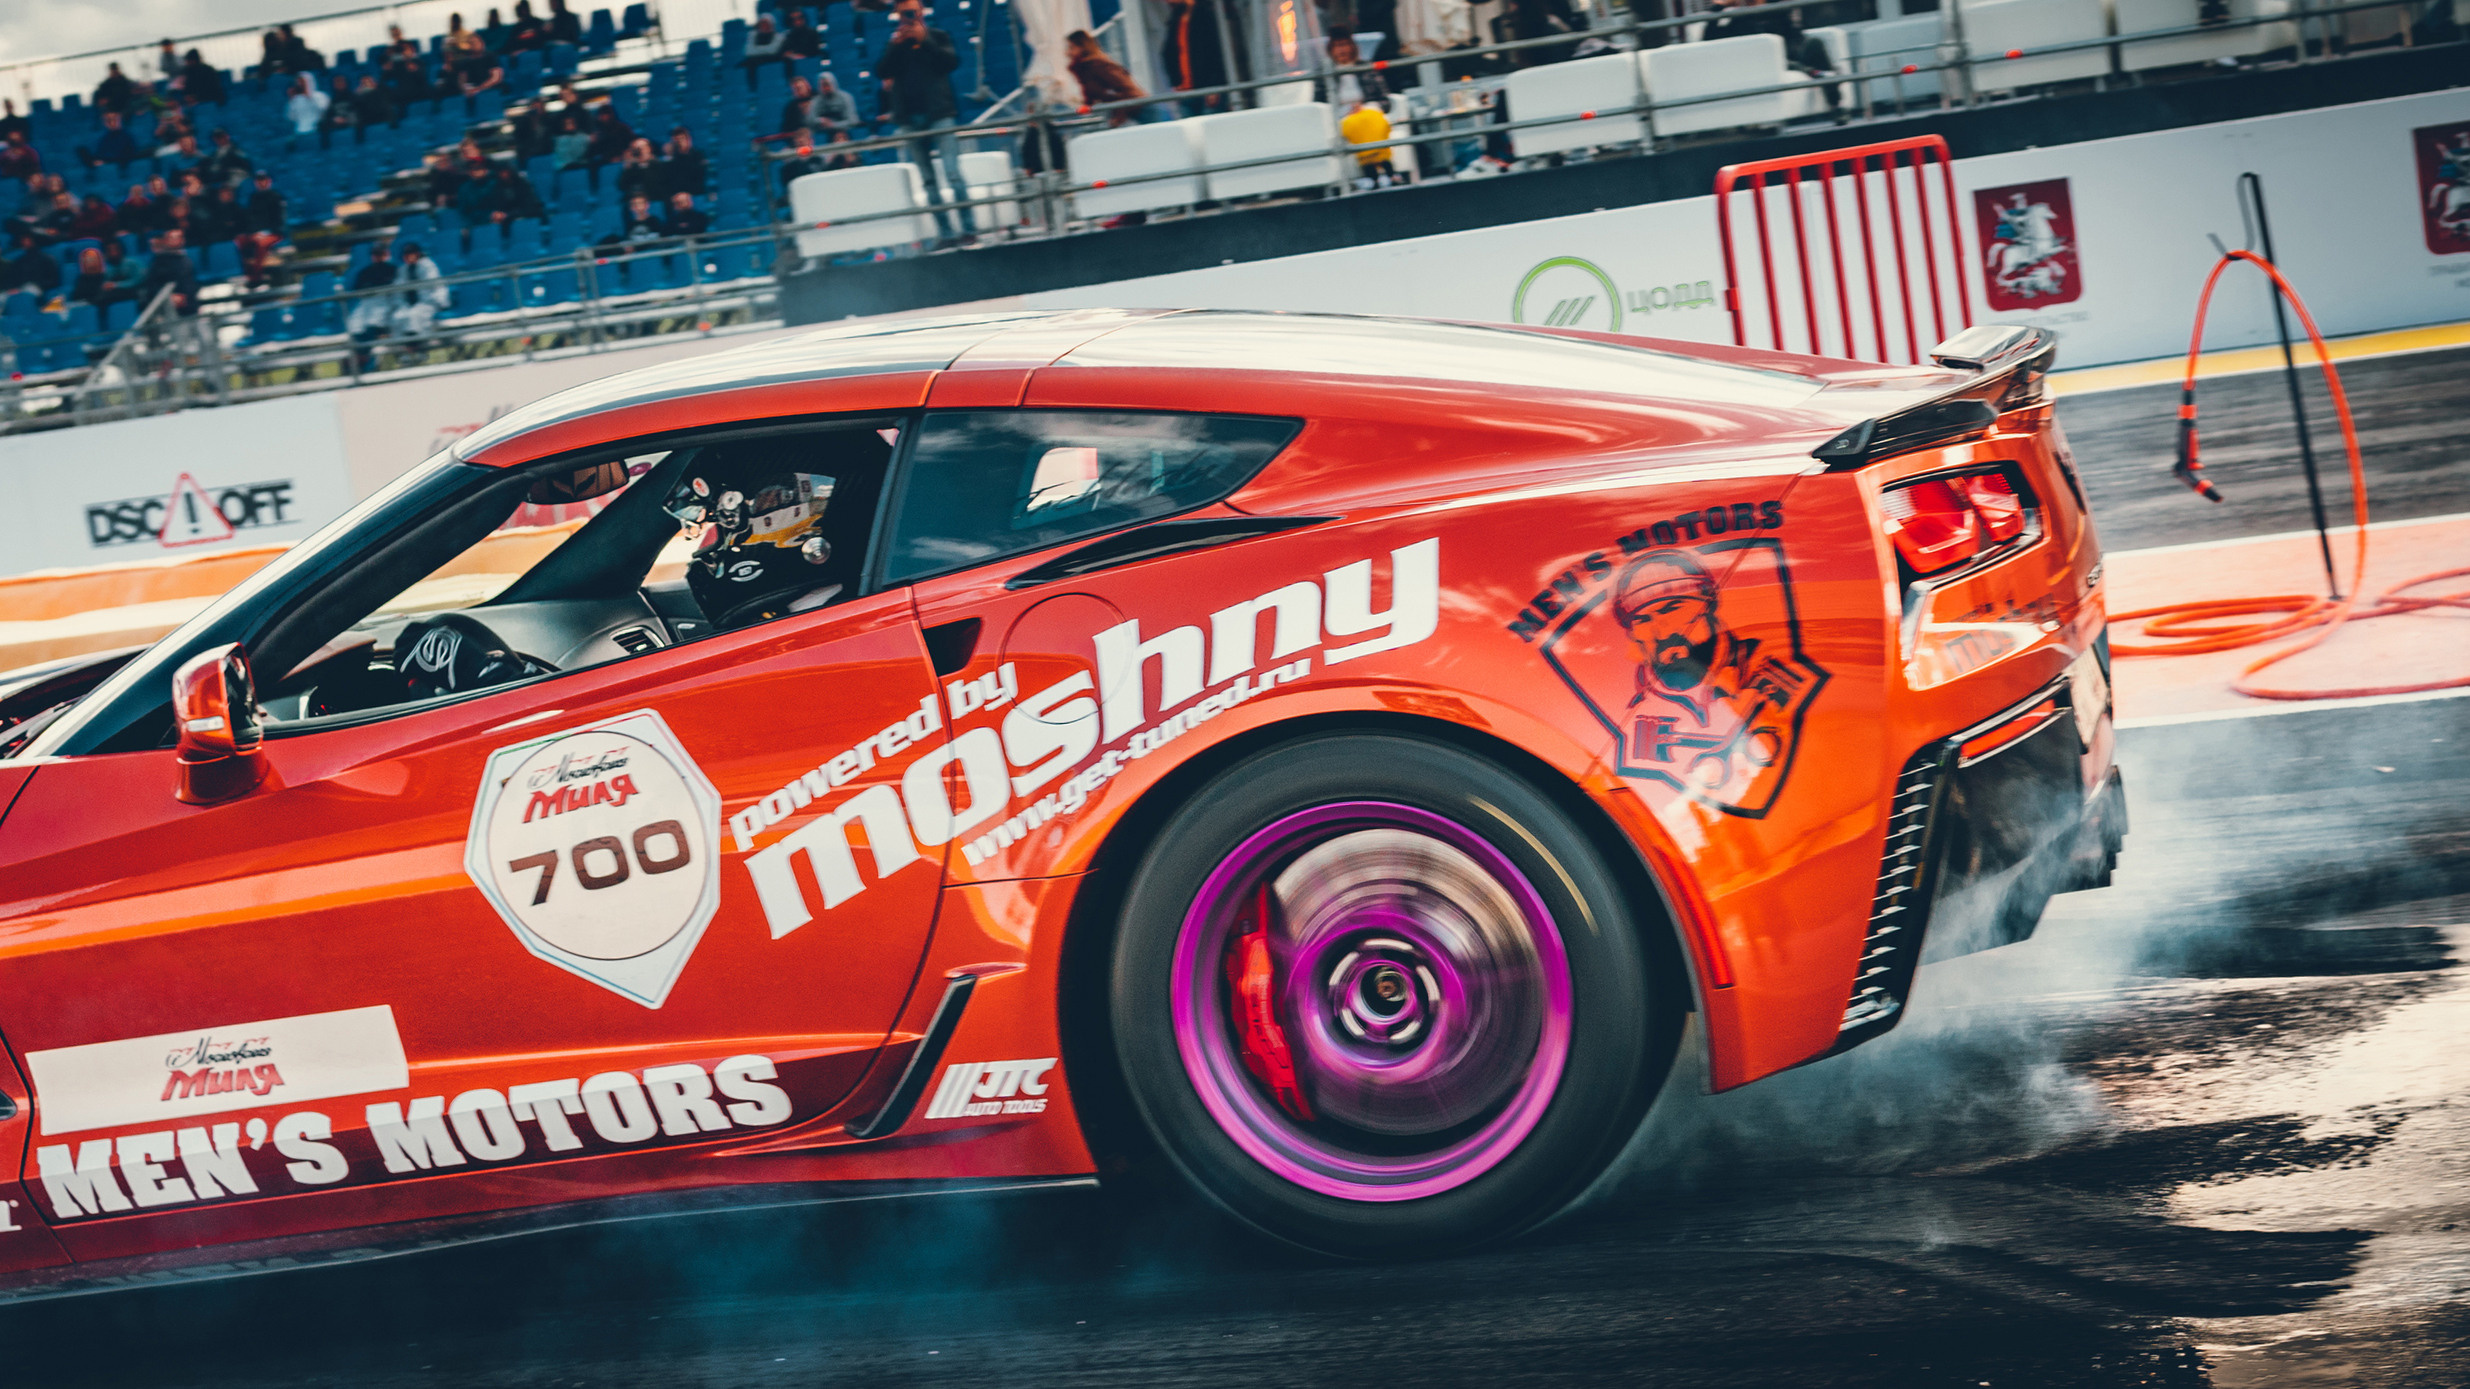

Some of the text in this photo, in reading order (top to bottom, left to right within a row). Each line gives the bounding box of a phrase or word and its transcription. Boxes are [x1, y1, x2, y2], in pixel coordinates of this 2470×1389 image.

[1626, 279, 1715, 316] ЦОДД
[86, 482, 293, 545] DSC OFF
[1615, 500, 1784, 555] MOTORS
[729, 661, 1019, 852] powered by
[744, 537, 1440, 940] moshny
[961, 657, 1312, 867] www.get-tuned.ru
[521, 773, 640, 824] Миля
[508, 819, 690, 906] 700
[161, 1063, 285, 1101] Миля
[37, 1053, 793, 1219] MEN'S MOTORS
